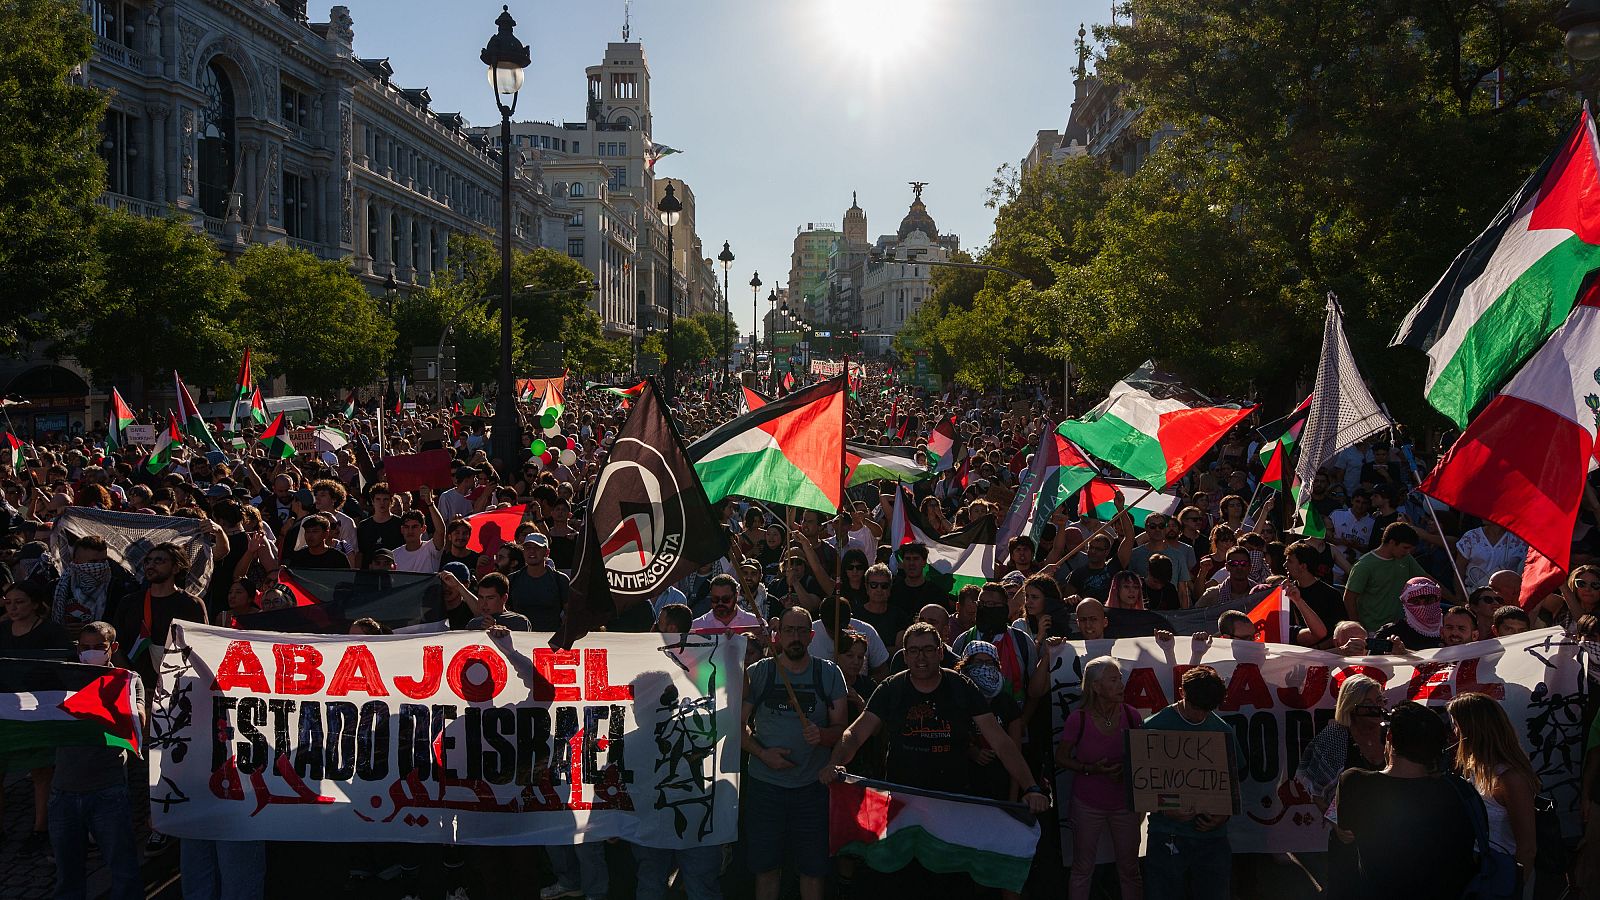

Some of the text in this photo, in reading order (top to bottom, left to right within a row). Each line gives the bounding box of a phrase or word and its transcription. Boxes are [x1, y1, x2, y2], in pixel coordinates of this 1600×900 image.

[209, 640, 635, 703] ABAJO EL
[211, 695, 636, 786] ESTADO DE ISRAEL
[1146, 733, 1214, 764] FUCK
[1133, 767, 1229, 793] GENOCIDE
